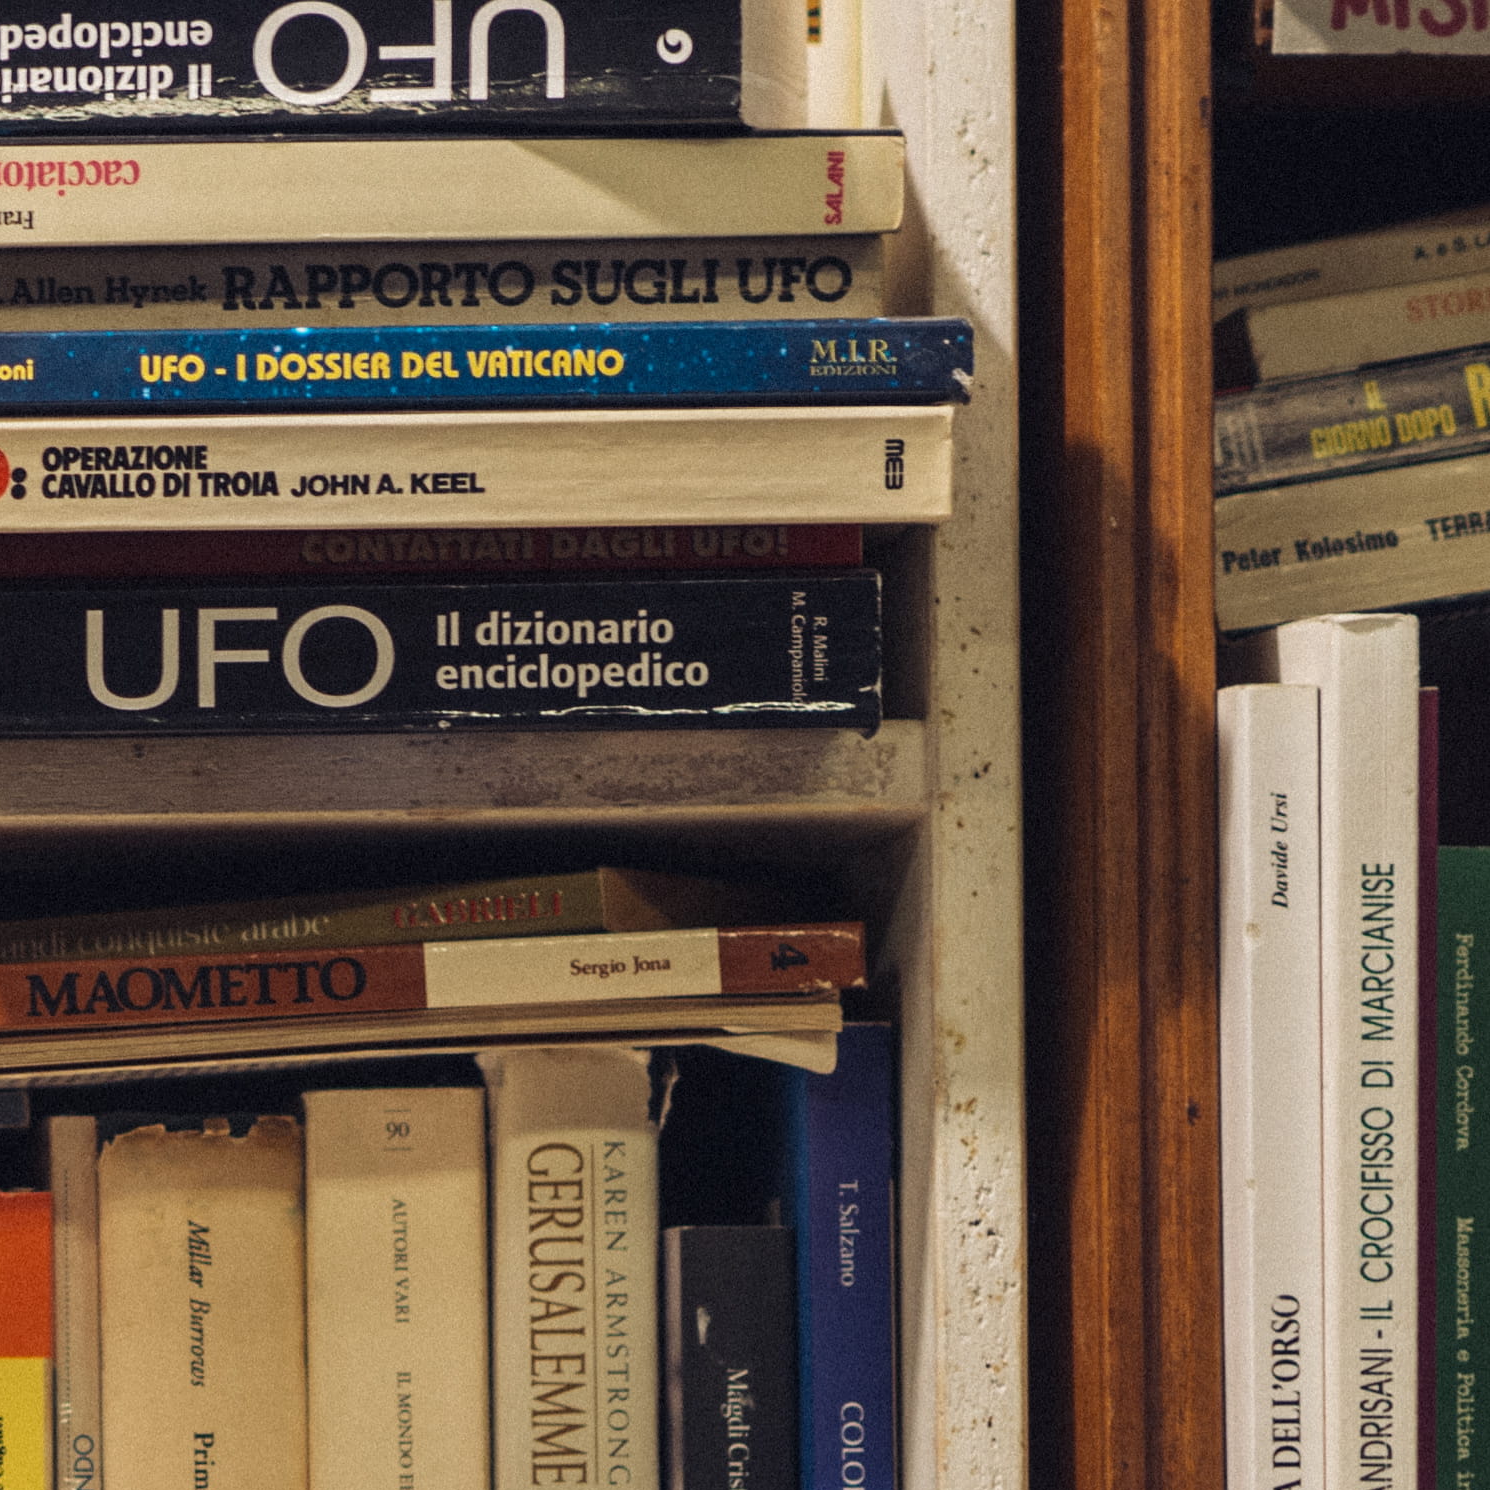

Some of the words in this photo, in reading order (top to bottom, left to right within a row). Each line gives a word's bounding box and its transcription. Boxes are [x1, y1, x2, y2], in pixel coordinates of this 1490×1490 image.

[188, 65, 212, 99] Il
[825, 152, 843, 225] SALANI
[229, 268, 534, 312] RAPPORTO
[553, 260, 717, 303] SUGLI
[737, 257, 852, 302] UFO
[141, 355, 204, 382] UFO
[237, 354, 246, 382] I
[257, 353, 389, 380] DOSSIER
[402, 352, 459, 378] DEL
[468, 346, 623, 377] VATICANO
[809, 364, 897, 377] EDIZIONI
[811, 340, 897, 363] M.I.R.
[43, 446, 206, 471] OPERAZIONE
[43, 469, 154, 498] CAVALLO
[167, 473, 192, 496] DI
[198, 472, 278, 496] TROIA
[291, 474, 370, 497] JOHN
[376, 474, 403, 494] A.
[411, 473, 485, 494] KEEL
[87, 605, 394, 710] UFO
[1271, 793, 1287, 833] Ursi
[1271, 841, 1288, 908] Davide
[570, 959, 626, 978] Sergio
[633, 956, 671, 974] Jona
[1361, 864, 1394, 1041] MARCIANISE
[27, 954, 372, 1016] MAOMETTO
[1361, 1061, 1393, 1088] DI
[604, 1142, 627, 1250] KAREN
[1360, 1107, 1394, 1283] CROCIFISSO
[527, 1143, 587, 1485] GERUSALEMME
[1360, 1300, 1393, 1320] IL
[606, 1269, 630, 1485] ARMSTRONG
[1272, 1295, 1301, 1468] DELL'ORSO
